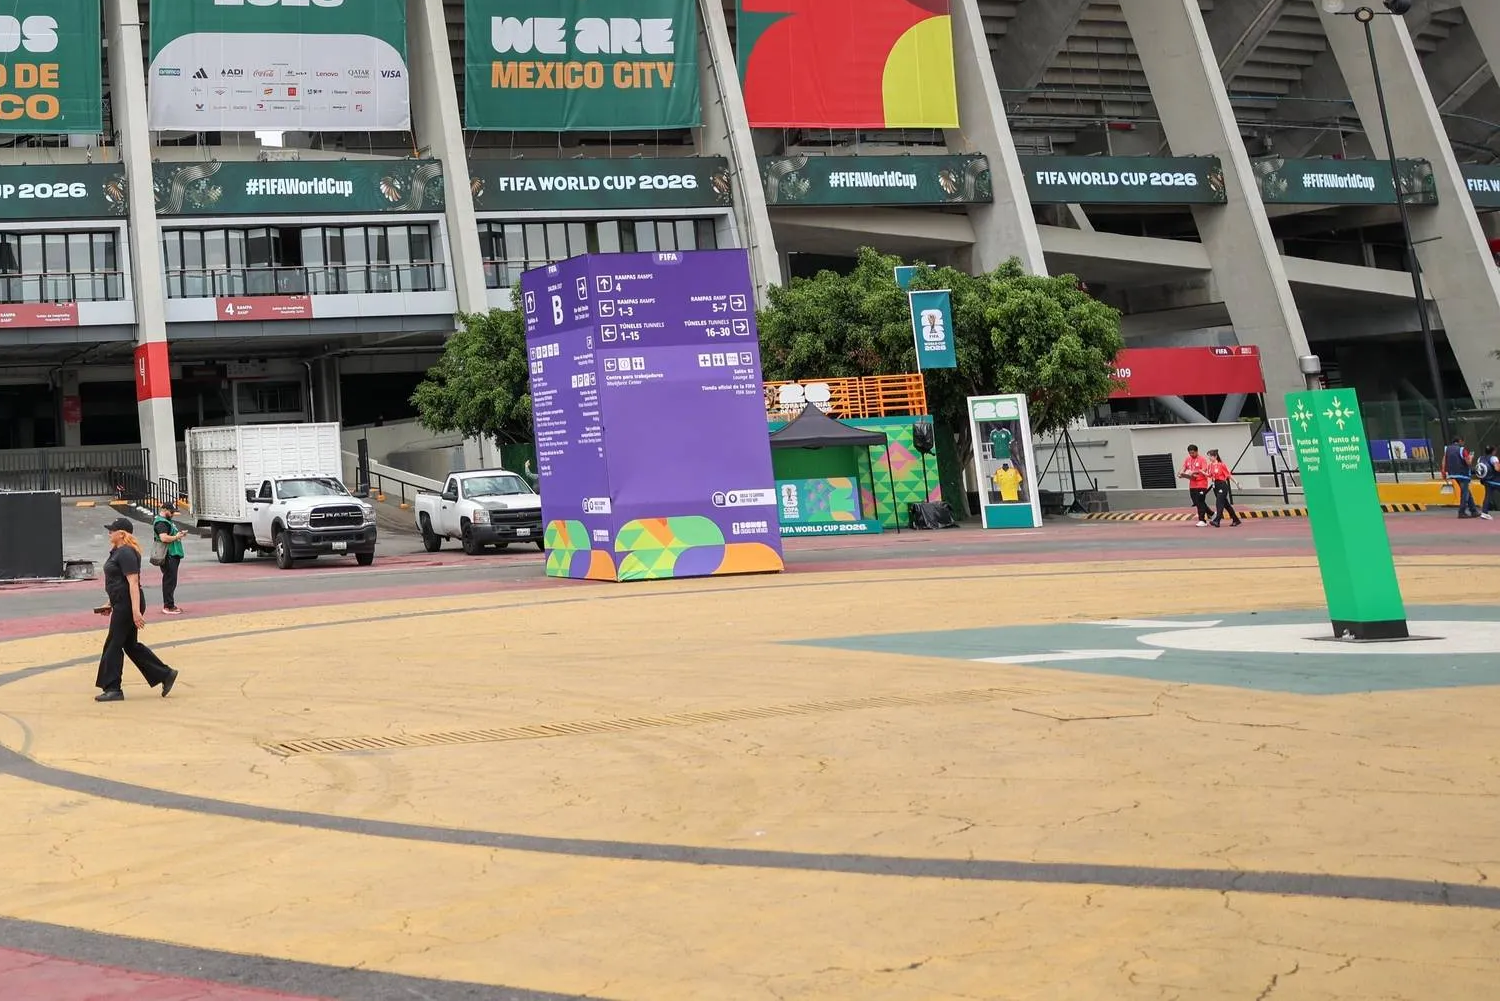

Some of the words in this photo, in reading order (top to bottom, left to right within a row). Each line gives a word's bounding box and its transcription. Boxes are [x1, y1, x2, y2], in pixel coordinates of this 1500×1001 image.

[491, 16, 567, 54] WE
[14, 63, 60, 89] DE
[380, 70, 401, 78] VISA
[491, 61, 604, 89] MEXICO
[613, 61, 674, 89] CITY
[499, 175, 538, 192] FIFA
[539, 176, 600, 191] WORLD
[603, 176, 636, 190] CUP
[639, 174, 696, 190] 2026
[829, 170, 917, 189] #FIFAWorldCup
[1036, 171, 1067, 185] FIFA
[1067, 171, 1119, 185] WORLD
[1120, 172, 1148, 185] CUP
[1150, 172, 1197, 186] 2026
[1302, 172, 1375, 191] #FIFAWorldCup
[1466, 178, 1491, 192] FIFA
[18, 182, 87, 198] 2026
[245, 177, 353, 198] #FIFAWorldCup
[658, 253, 677, 261] FIFA
[615, 282, 622, 292] 4
[225, 303, 234, 316] 4
[551, 295, 563, 326] B
[620, 321, 642, 329] TÚNELES
[684, 319, 707, 327] TÚNELES
[1328, 436, 1349, 444] Punto
[1332, 444, 1360, 452] reunión
[1335, 454, 1360, 462] Meeting
[795, 525, 823, 533] WORLD
